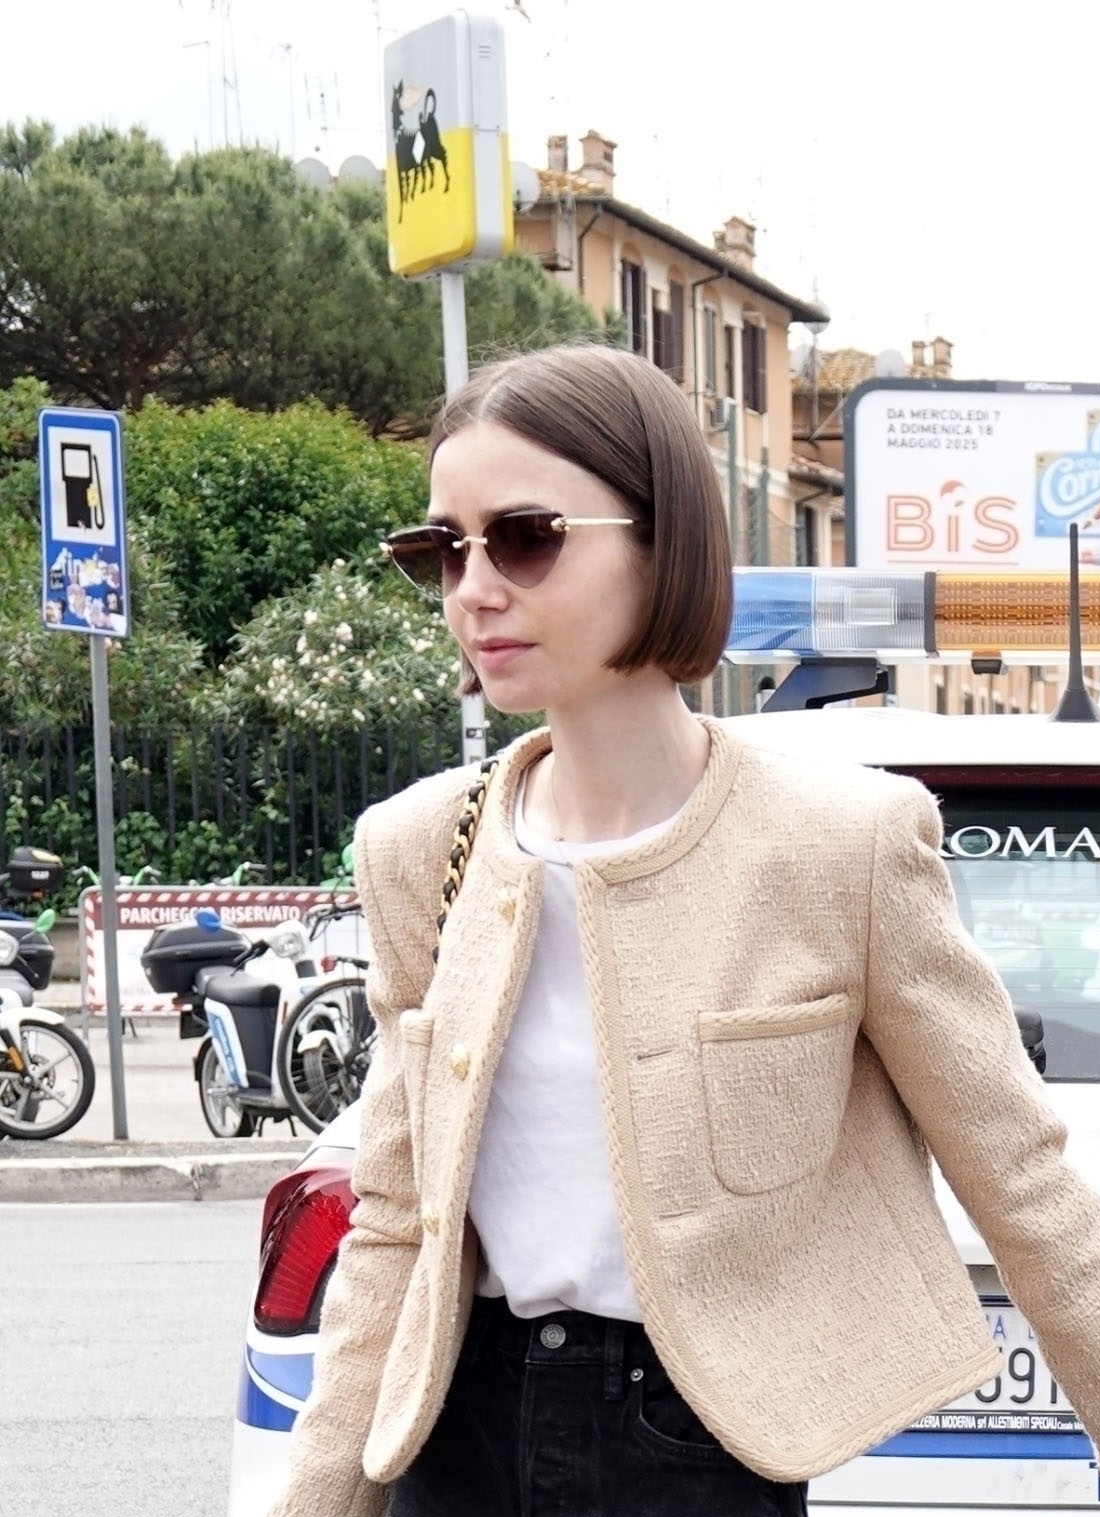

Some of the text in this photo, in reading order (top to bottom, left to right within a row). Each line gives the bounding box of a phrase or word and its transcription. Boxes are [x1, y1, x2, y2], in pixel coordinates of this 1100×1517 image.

[887, 408, 905, 420] DA
[993, 410, 1001, 422] 7
[887, 423, 896, 434] A
[901, 423, 973, 436] DOMENICA
[887, 438, 979, 450] MAGGIO 2025
[120, 905, 300, 925] PARCHEGG RISERVATO
[941, 1415, 976, 1429] MODERNA
[988, 1416, 1030, 1430] ALLESTIMENTI
